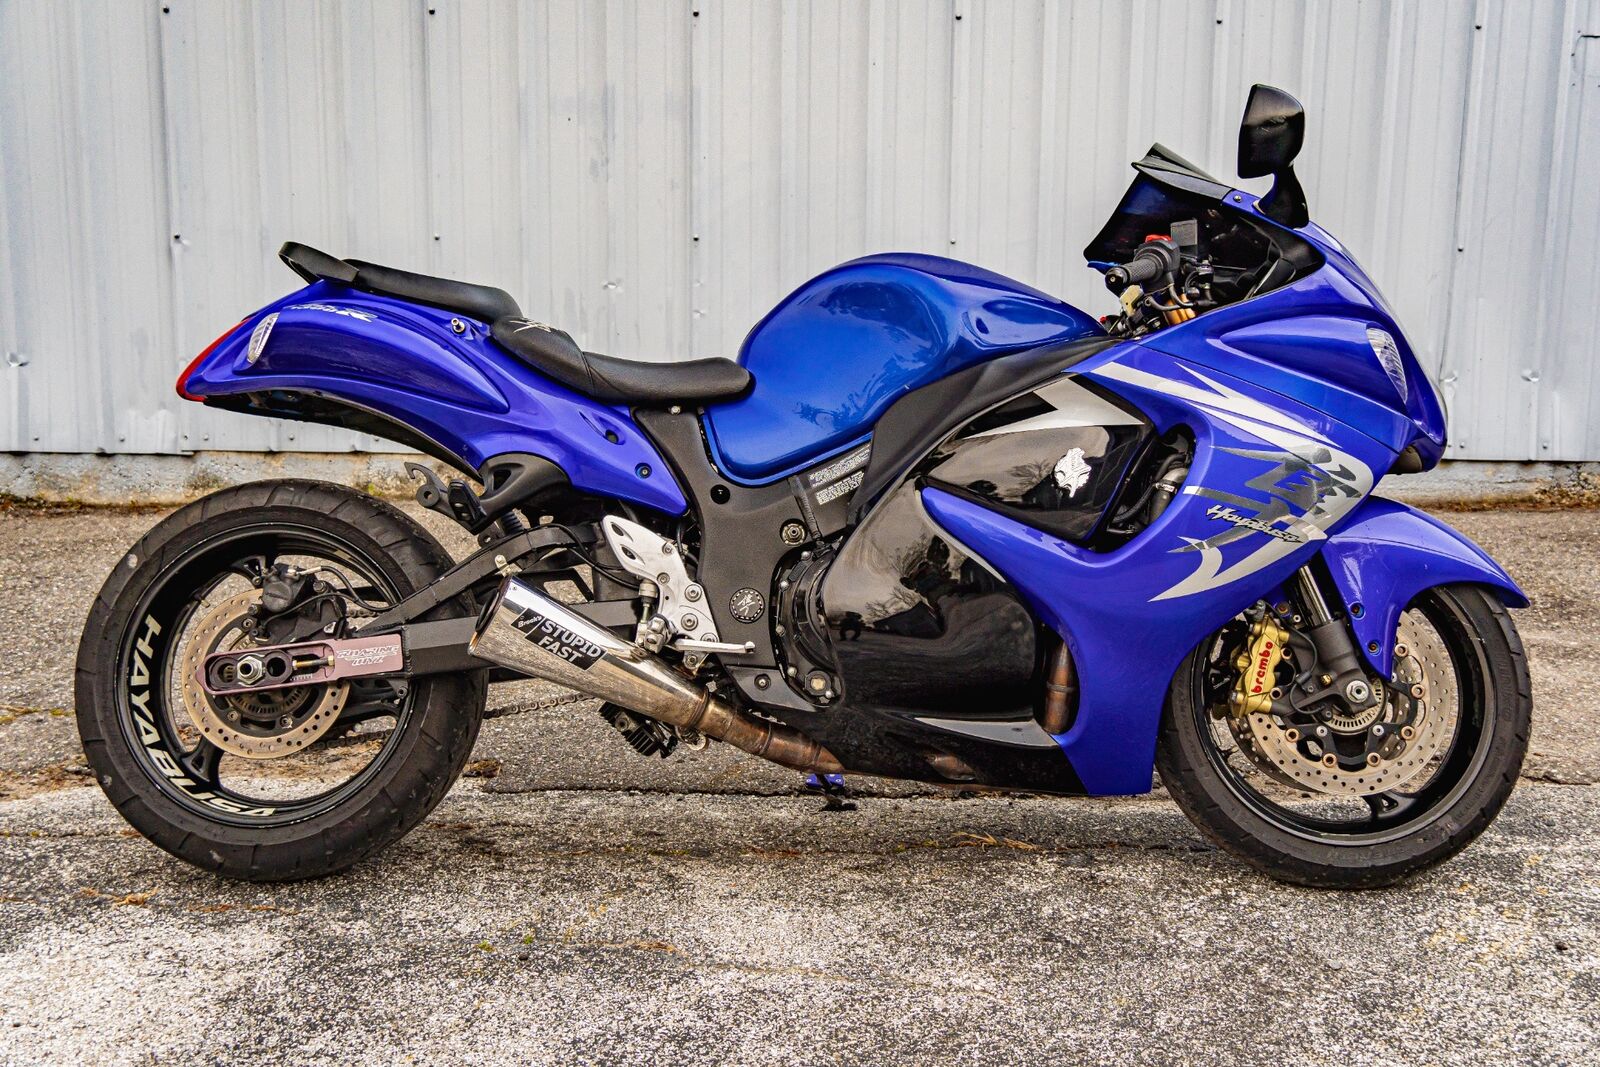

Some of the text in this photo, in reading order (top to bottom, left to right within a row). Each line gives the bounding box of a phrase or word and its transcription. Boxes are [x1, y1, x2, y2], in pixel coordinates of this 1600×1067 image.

[1206, 504, 1303, 543] Hayabusa
[537, 635, 583, 663] FAST
[541, 620, 602, 658] STUPID
[1250, 641, 1274, 693] brembo
[131, 614, 276, 817] HAYABUSA
